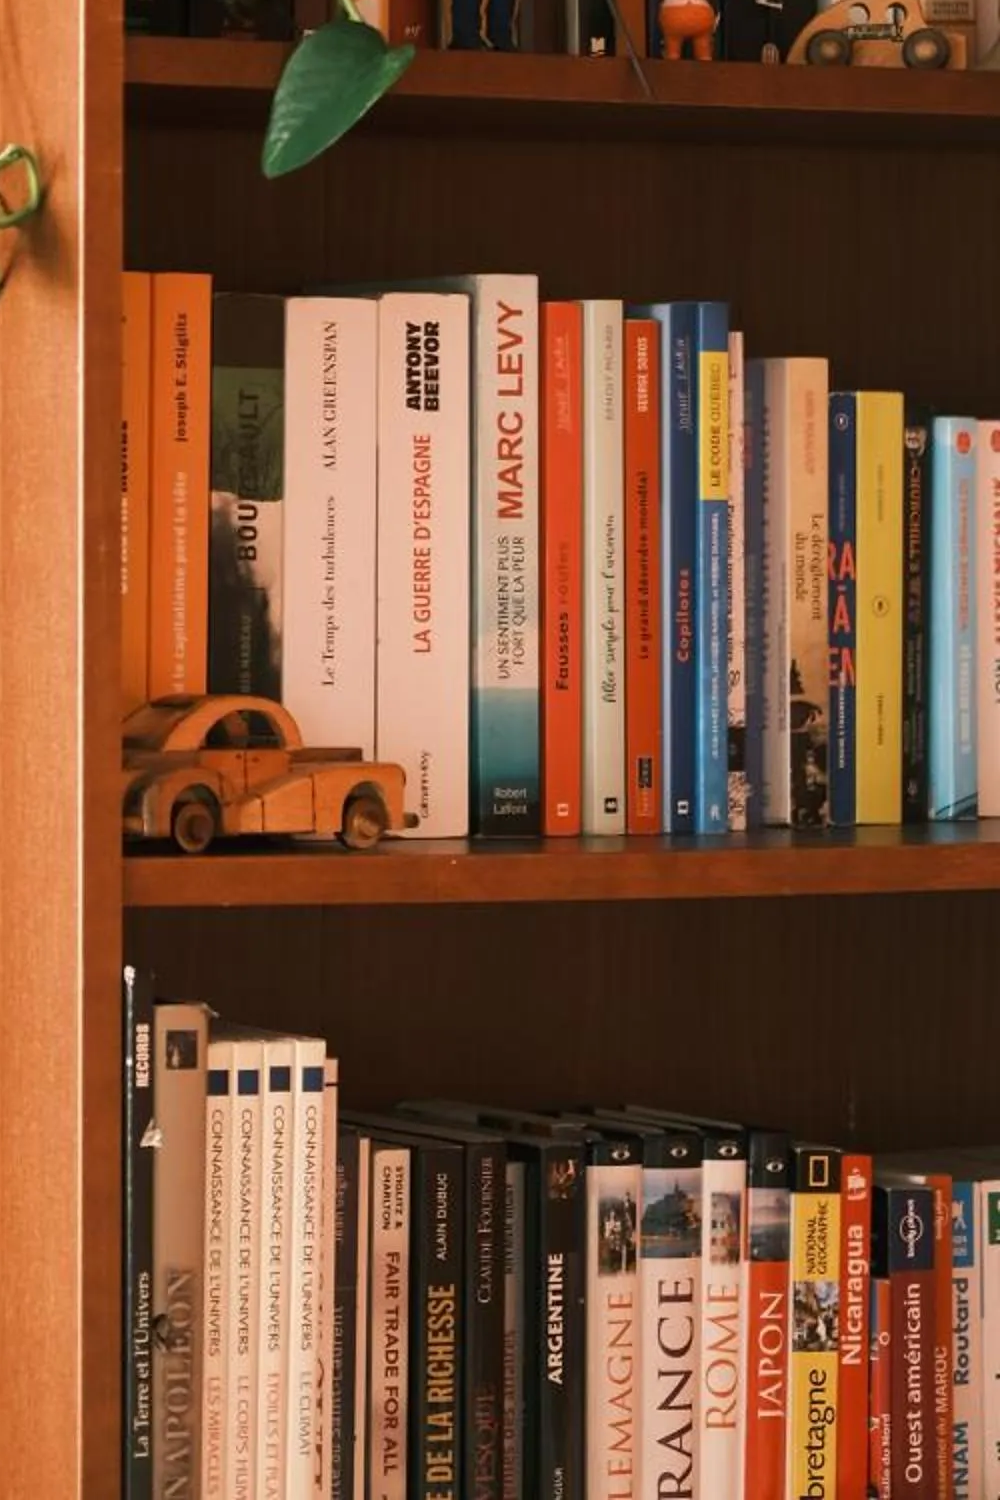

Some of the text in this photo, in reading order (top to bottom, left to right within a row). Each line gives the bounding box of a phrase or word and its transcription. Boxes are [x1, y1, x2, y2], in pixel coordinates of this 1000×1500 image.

[173, 312, 189, 370] Stiglitz
[174, 374, 187, 388] E.
[406, 321, 421, 411] ANTONY
[423, 320, 440, 412] BEEVOR
[173, 392, 189, 443] Joseph
[497, 300, 523, 520] MARC LEVY
[709, 425, 721, 466] CODE
[320, 321, 341, 687] Le Temps des turbulences ALAN GREENSPAN
[636, 470, 648, 530] mondial
[709, 470, 721, 488] LE
[412, 434, 432, 654] LA GUERRE D'ESPAGNE
[795, 532, 809, 603] du monde
[810, 513, 825, 622] Le dérèglement
[173, 569, 188, 660] capitalisme
[497, 535, 510, 680] UN SENTIMENT PLUS
[512, 535, 527, 666] FORT QUE LA PEUR
[638, 599, 652, 642] grand
[676, 567, 693, 663] Copilotes
[555, 612, 569, 691] Fausses
[135, 1023, 150, 1088] RECORDS
[210, 1109, 224, 1244] CONNAISSANCE
[239, 1108, 253, 1243] CONNAISSANCE
[270, 1105, 285, 1239] CONNAISSANCE
[382, 1165, 392, 1230] CHARLTON
[209, 1250, 222, 1271] DE
[239, 1248, 251, 1269] DE
[270, 1244, 282, 1263] DE
[299, 1105, 317, 1457] CONNAISSANCE DE L'UNIVERS LE CLIMAT
[817, 1201, 829, 1275] GEOGRAPHIC
[208, 1275, 221, 1357] L'UNIVERS
[238, 1274, 250, 1356] L'UNIVERS
[268, 1270, 281, 1352] L'UNIVERS
[427, 1173, 454, 1484] DE LA RICHESSE ALAIN DUBUC
[547, 1253, 564, 1385] ARGENTINE
[841, 1224, 868, 1366] Nicaragua
[952, 1277, 969, 1386] Routard
[132, 1271, 149, 1459] La Terre et l'Univers
[237, 1375, 249, 1390] LE
[383, 1251, 401, 1476] FAIR TRADE FOR ALL
[607, 1292, 633, 1500] LEMAGNE
[656, 1277, 694, 1500] RANCE
[705, 1284, 738, 1429] ROME
[757, 1292, 784, 1419] JAPON
[800, 1217, 835, 1500] bretagne NATIONAL
[904, 1283, 923, 1484] Ouest américain
[935, 1346, 948, 1413] MAROC
[207, 1411, 221, 1495] MIRACLES
[236, 1399, 249, 1454] CORPS
[881, 1413, 890, 1446] Nord
[881, 1448, 890, 1466] du
